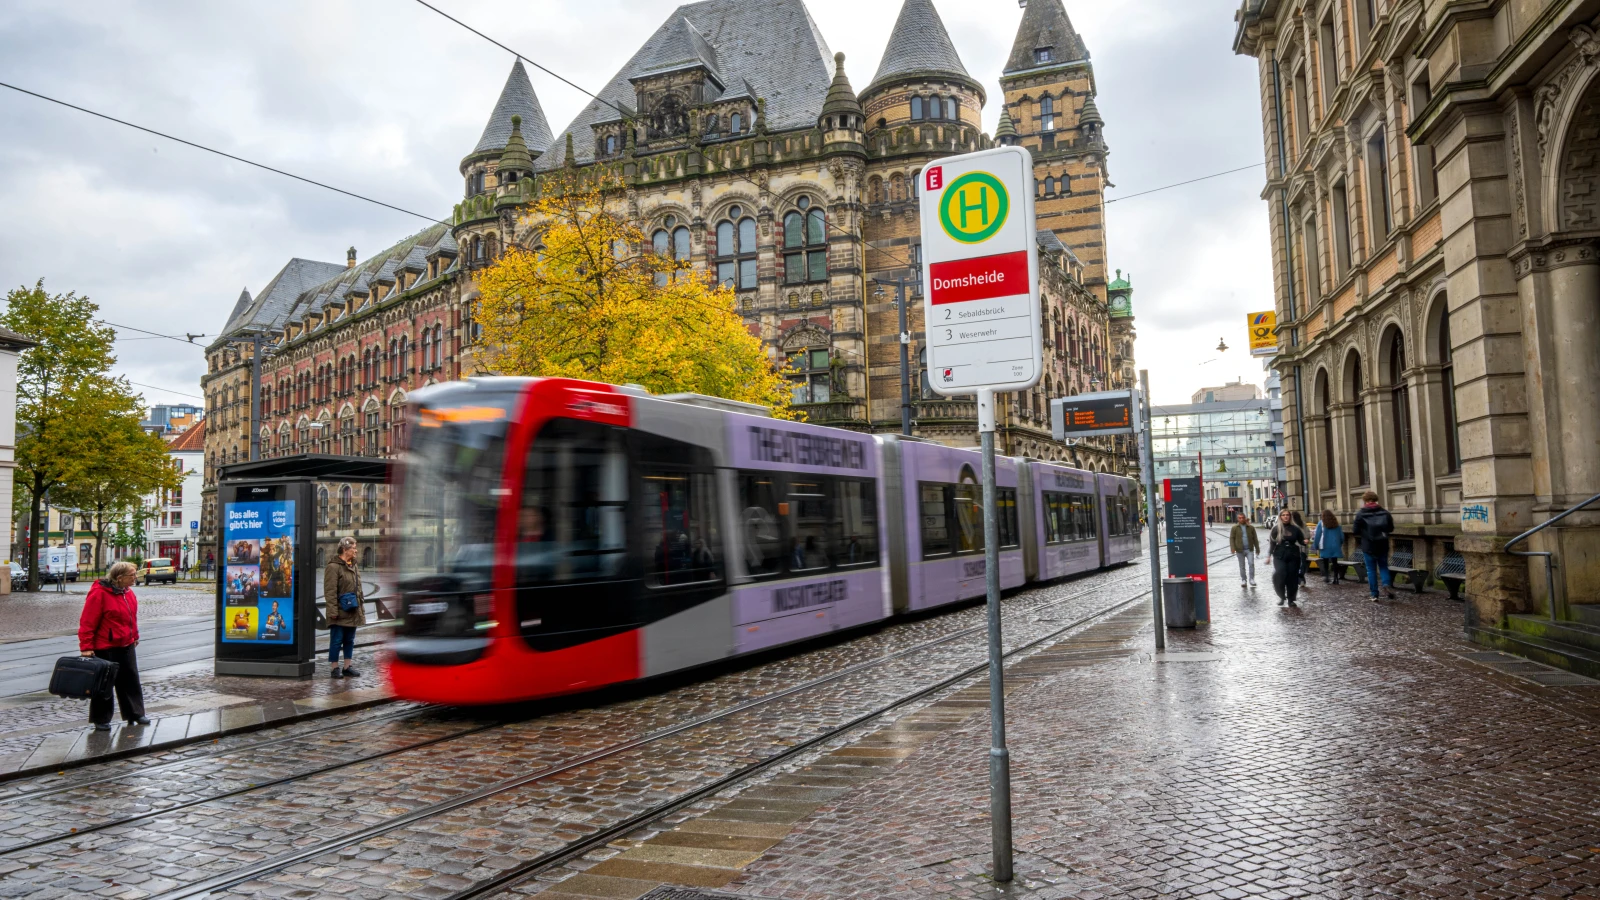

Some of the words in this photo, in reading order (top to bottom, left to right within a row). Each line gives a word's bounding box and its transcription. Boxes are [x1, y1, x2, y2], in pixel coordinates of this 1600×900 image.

[930, 174, 939, 189] E
[959, 186, 988, 228] H
[933, 270, 1005, 290] Domsheide
[944, 308, 952, 320] 2
[958, 306, 1005, 318] Sebaldsbrück
[945, 328, 953, 341] 3
[959, 328, 997, 340] Weserwehr
[229, 510, 242, 519] Das
[243, 509, 259, 518] alles
[229, 519, 249, 531] gibt's
[248, 519, 263, 529] hier
